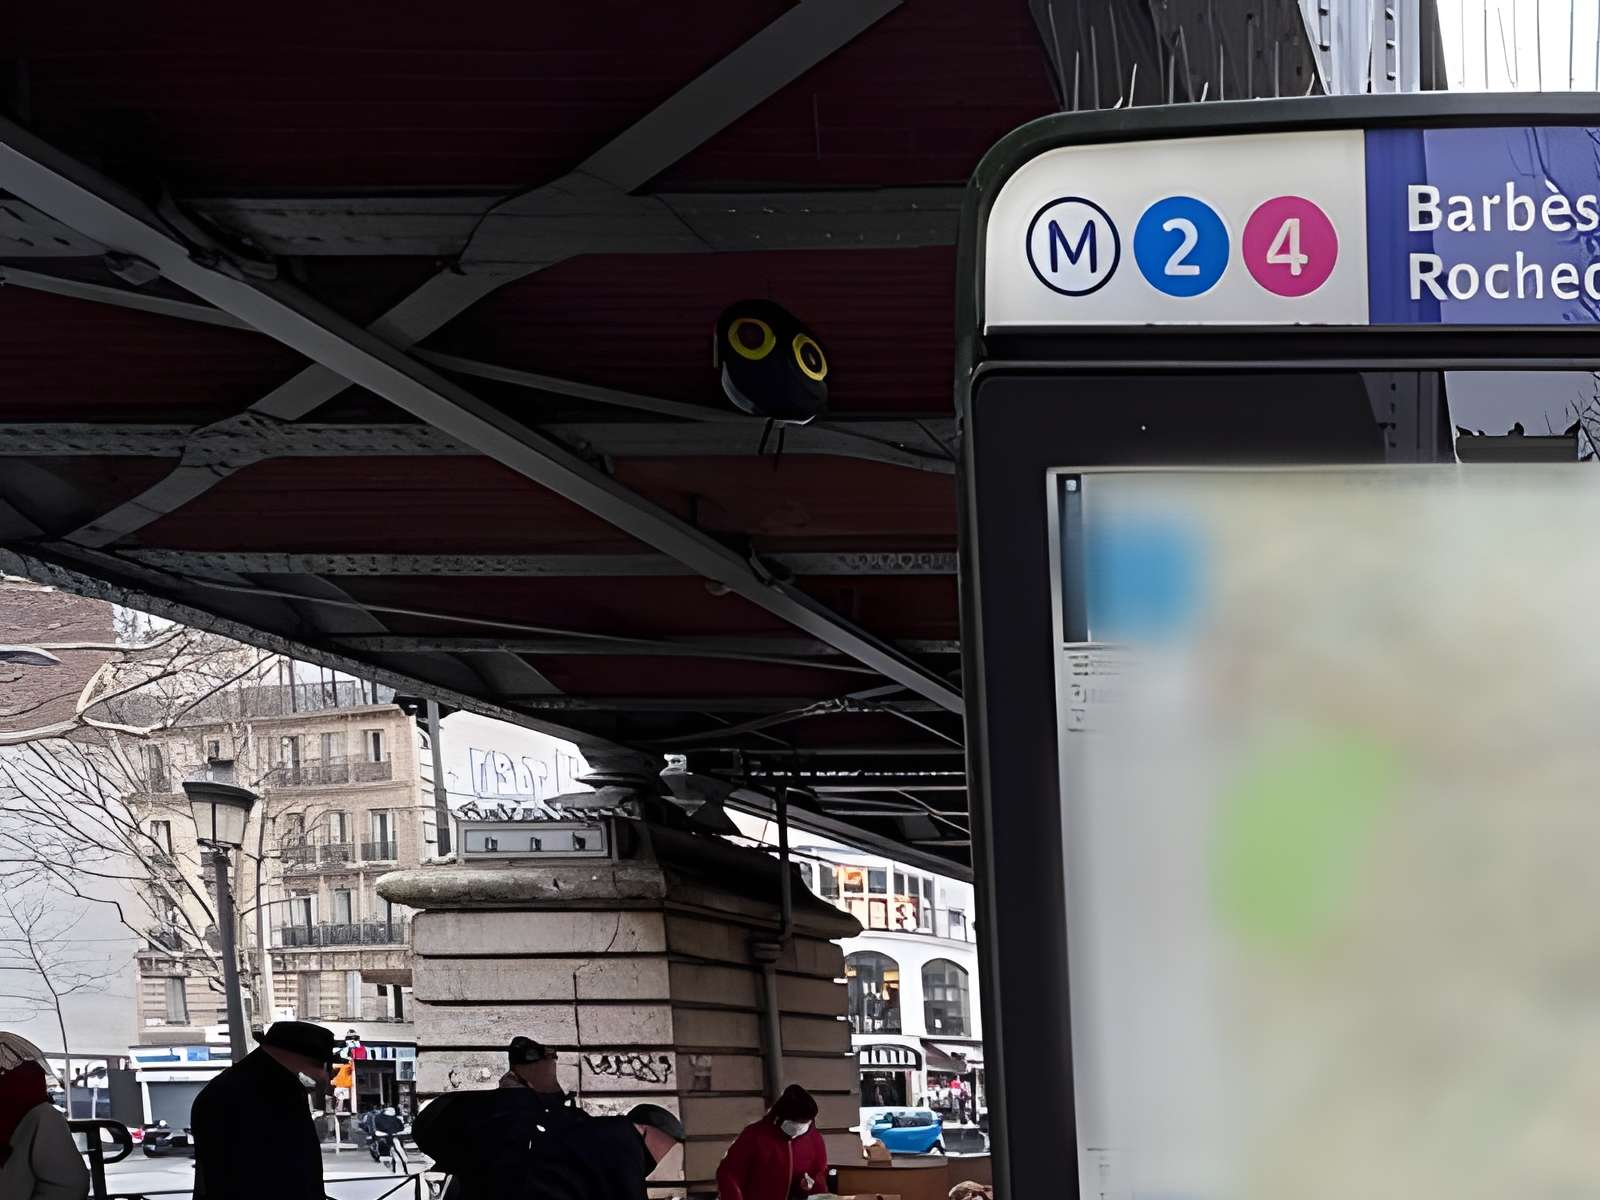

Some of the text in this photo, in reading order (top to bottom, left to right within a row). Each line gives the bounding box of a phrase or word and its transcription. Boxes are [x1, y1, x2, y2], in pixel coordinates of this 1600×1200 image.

[1408, 182, 1600, 232] Barbès
[1048, 218, 1309, 276] M 2 4
